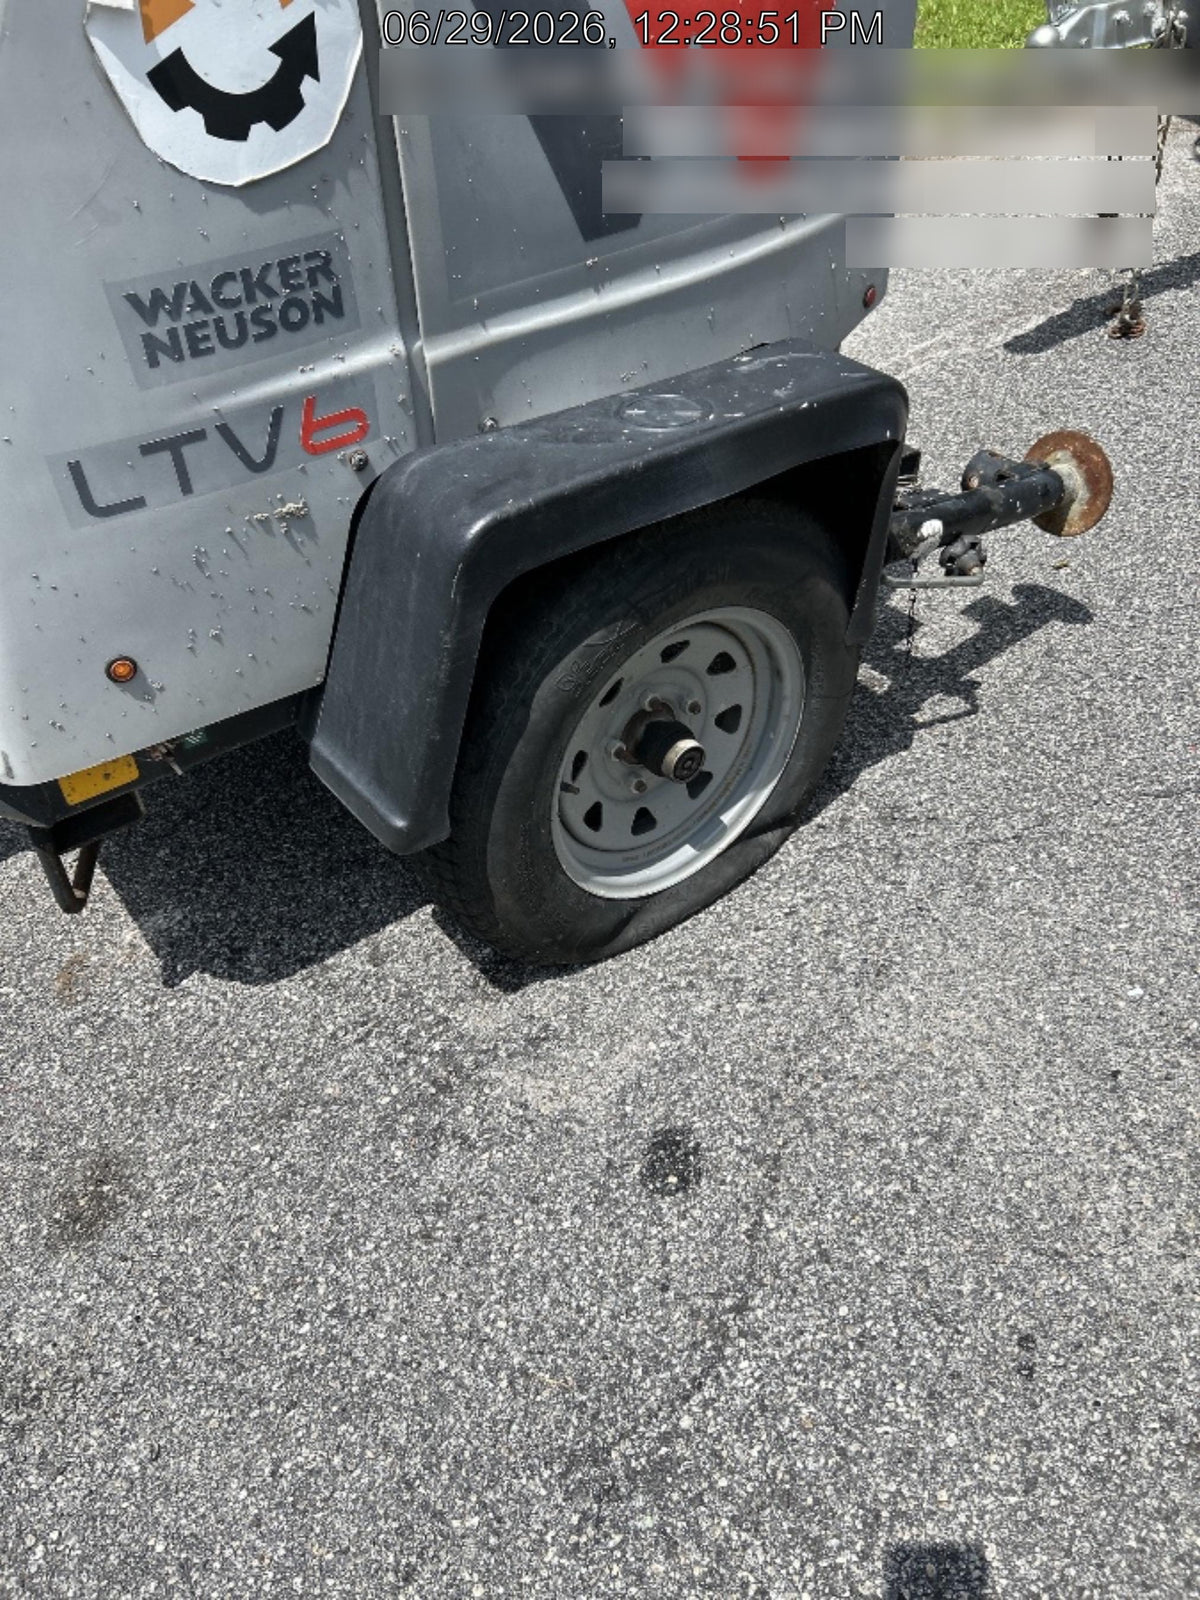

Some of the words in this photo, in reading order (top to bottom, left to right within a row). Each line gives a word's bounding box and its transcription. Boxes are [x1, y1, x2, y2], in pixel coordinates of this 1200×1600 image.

[122, 249, 342, 327] WACKER
[140, 284, 344, 368] NEUSON
[67, 395, 369, 518] LTV6
